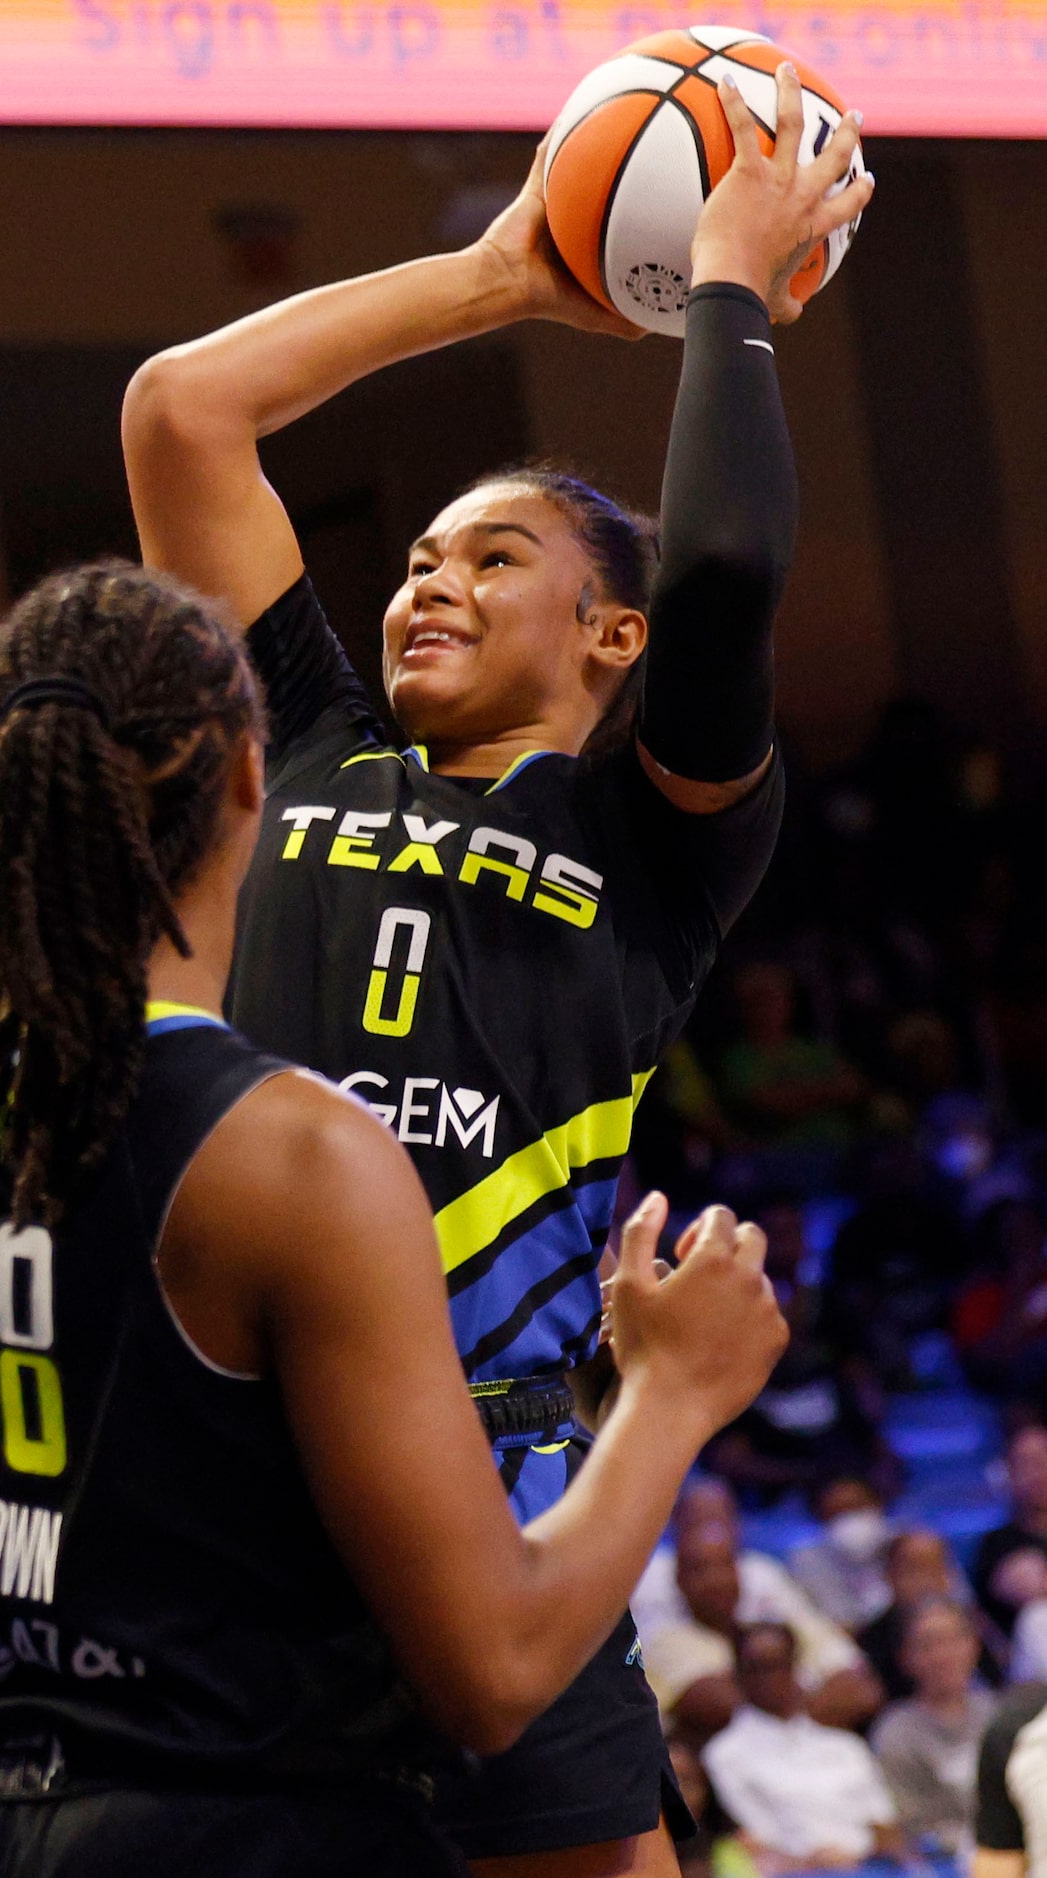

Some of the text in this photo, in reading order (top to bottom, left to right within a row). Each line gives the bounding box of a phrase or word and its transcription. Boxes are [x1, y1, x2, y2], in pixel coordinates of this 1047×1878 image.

[73, 0, 277, 80] Sign
[327, 3, 439, 80] up
[280, 805, 604, 929] TEXAS
[362, 906, 431, 1038] 0
[11, 1615, 146, 1680] AT&
